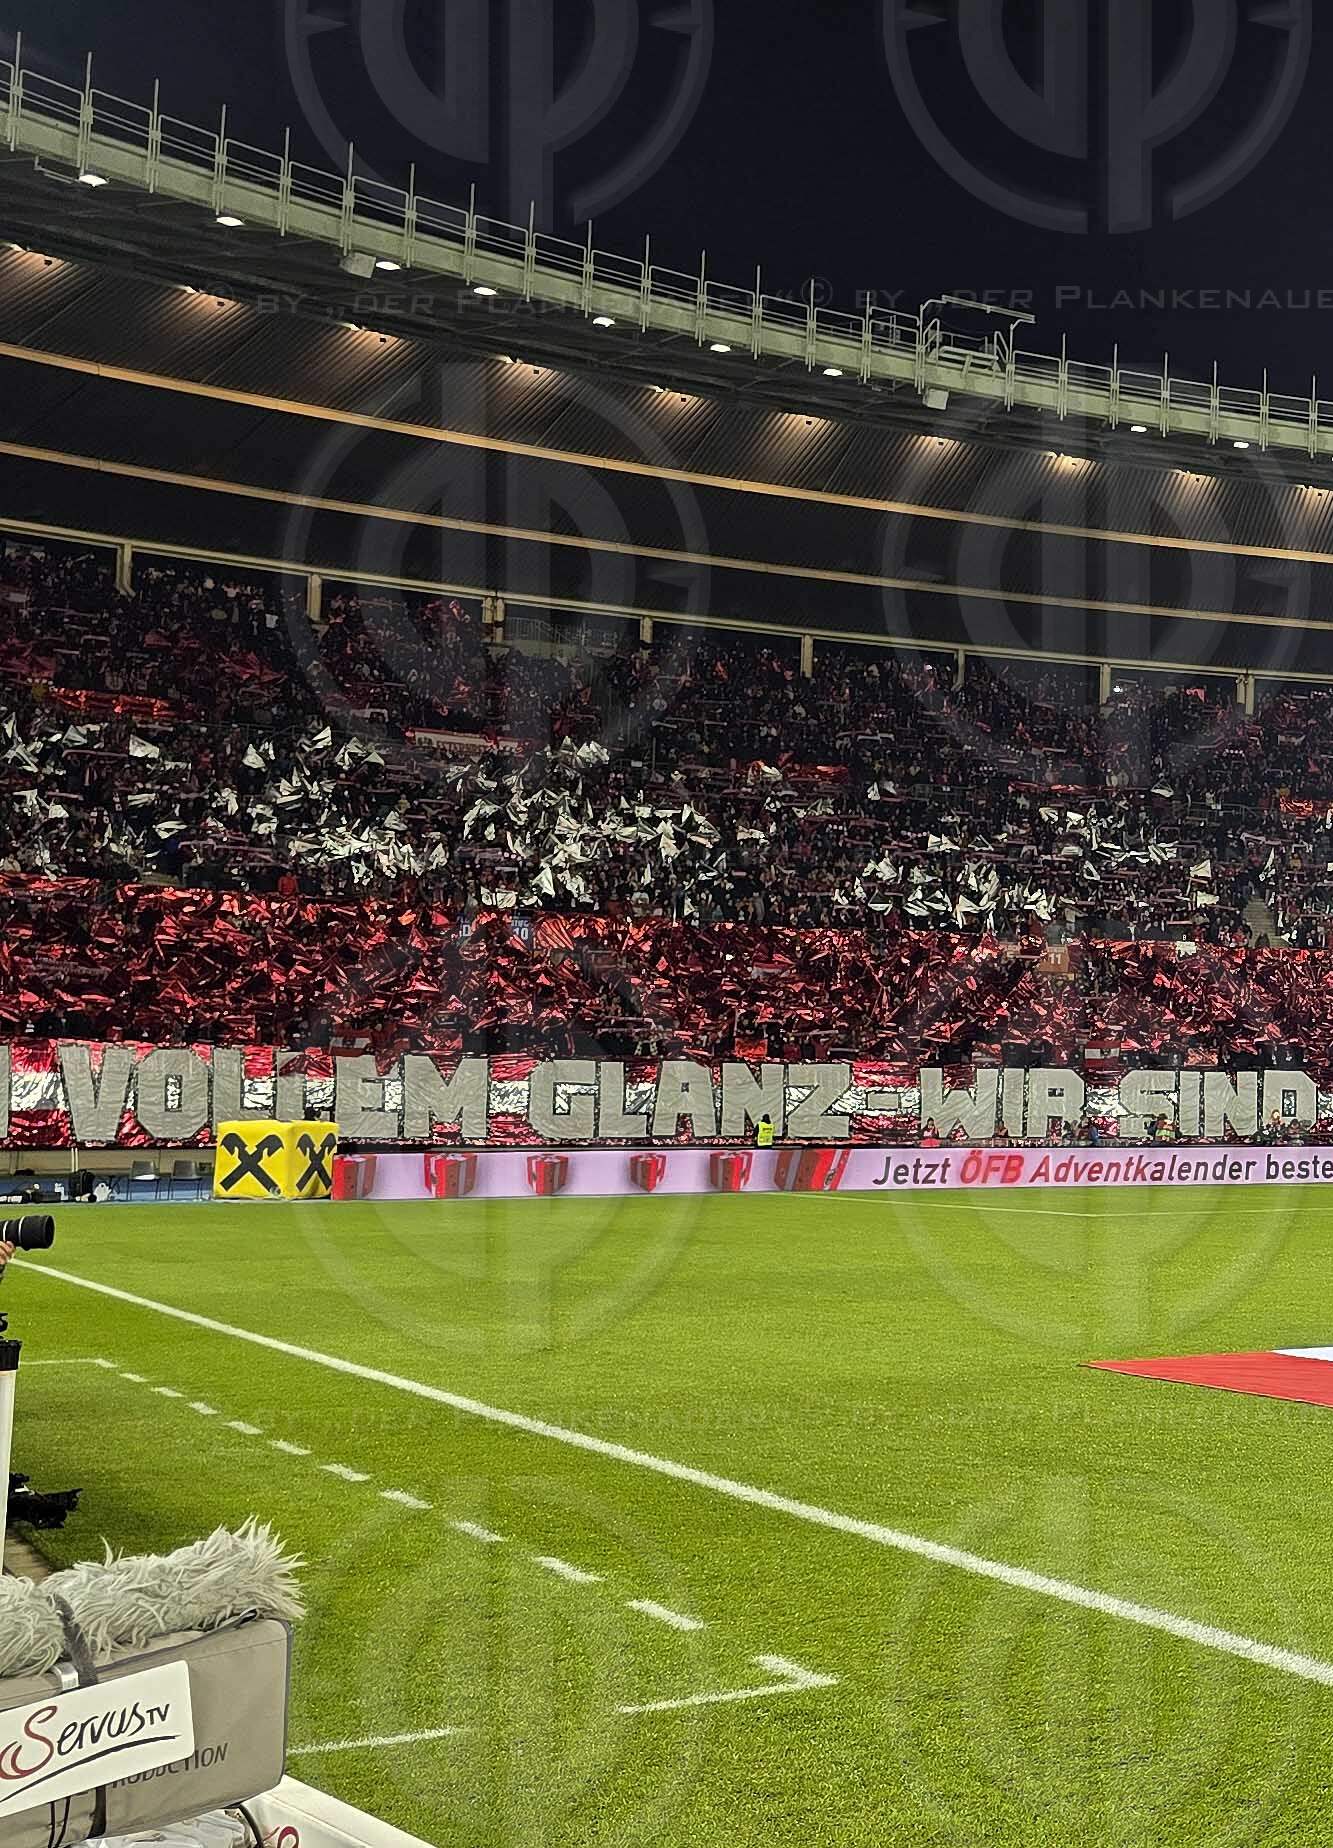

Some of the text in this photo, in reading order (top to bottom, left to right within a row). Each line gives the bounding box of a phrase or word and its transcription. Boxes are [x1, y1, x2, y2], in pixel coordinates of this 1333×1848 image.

[529, 1058, 851, 1140] GLANZ
[918, 1066, 1086, 1139] WIR
[1117, 1068, 1317, 1138] SIND
[873, 1156, 951, 1185] Jetzt
[960, 1150, 1023, 1184] ÖFB
[1029, 1152, 1258, 1184] Adventkalender
[107, 1742, 229, 1789] DUCTION
